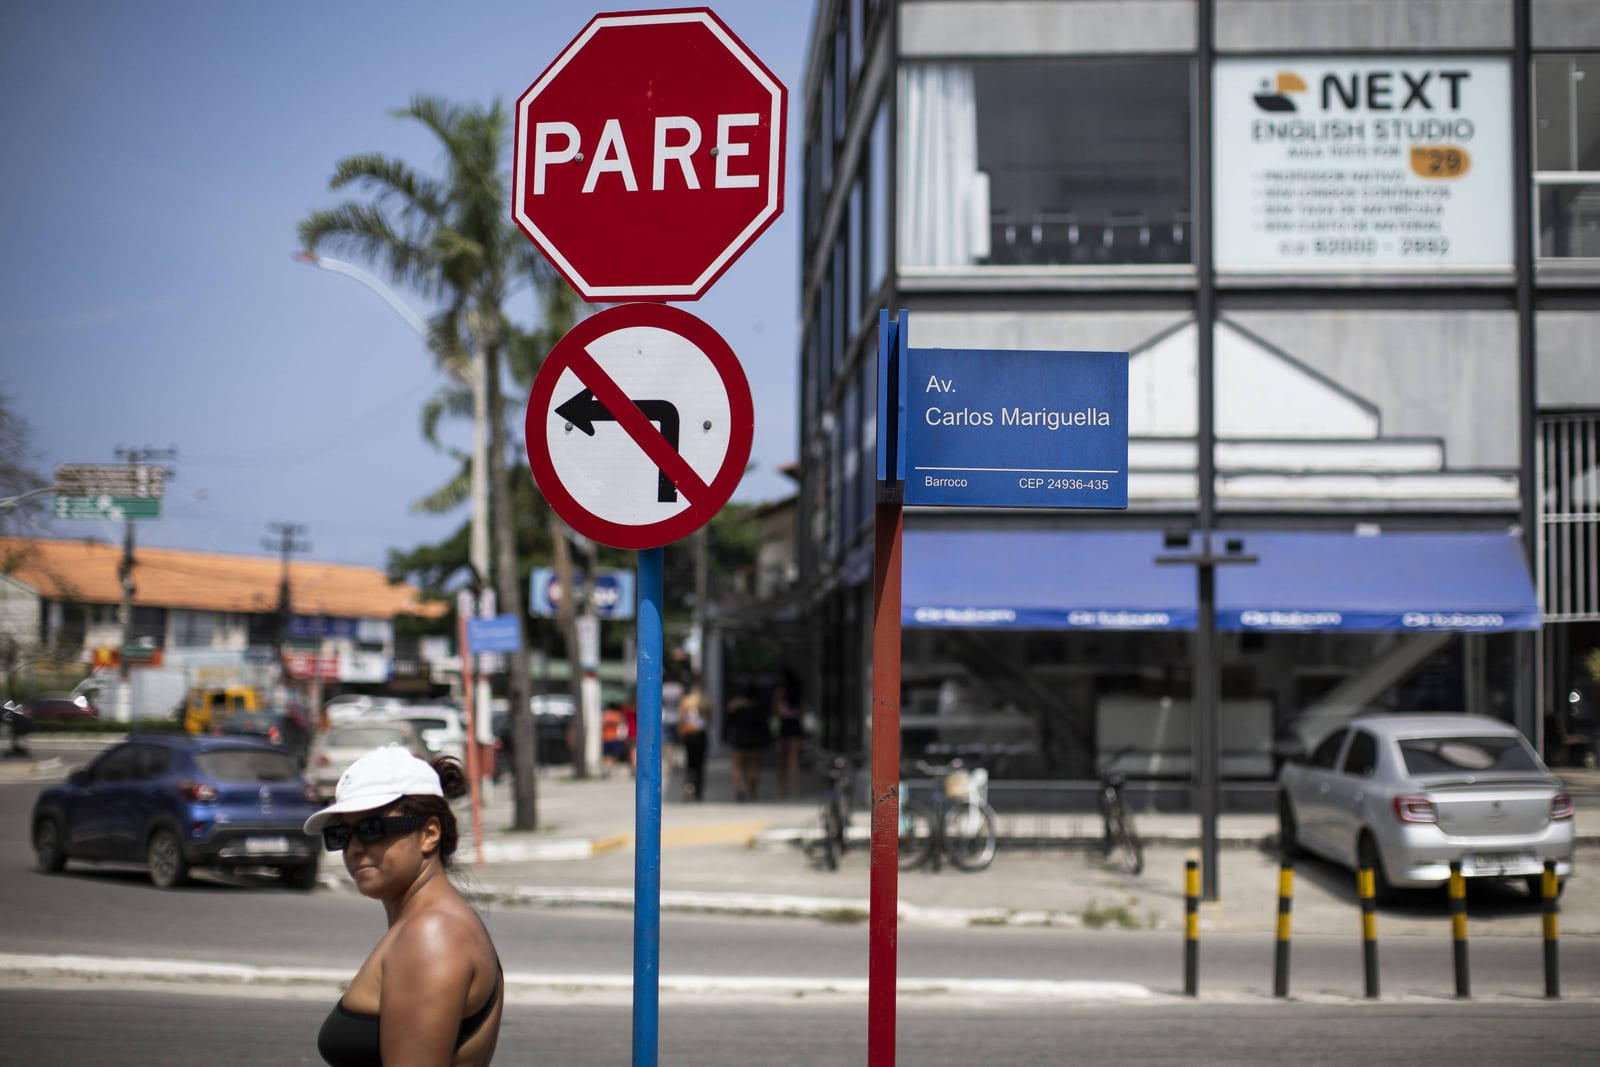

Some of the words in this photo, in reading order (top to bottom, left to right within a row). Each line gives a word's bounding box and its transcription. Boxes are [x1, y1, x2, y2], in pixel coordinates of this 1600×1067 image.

[1321, 71, 1471, 111] NEXT
[1251, 119, 1365, 142] ENGLISH
[1374, 119, 1475, 142] STUDIO
[533, 113, 760, 195] PARE
[925, 375, 956, 393] Av.
[925, 407, 994, 427] Carlos
[1001, 407, 1111, 431] Mariguella
[925, 476, 968, 488] Barroco
[1018, 477, 1044, 489] CEP
[1047, 479, 1109, 491] 24936-435
